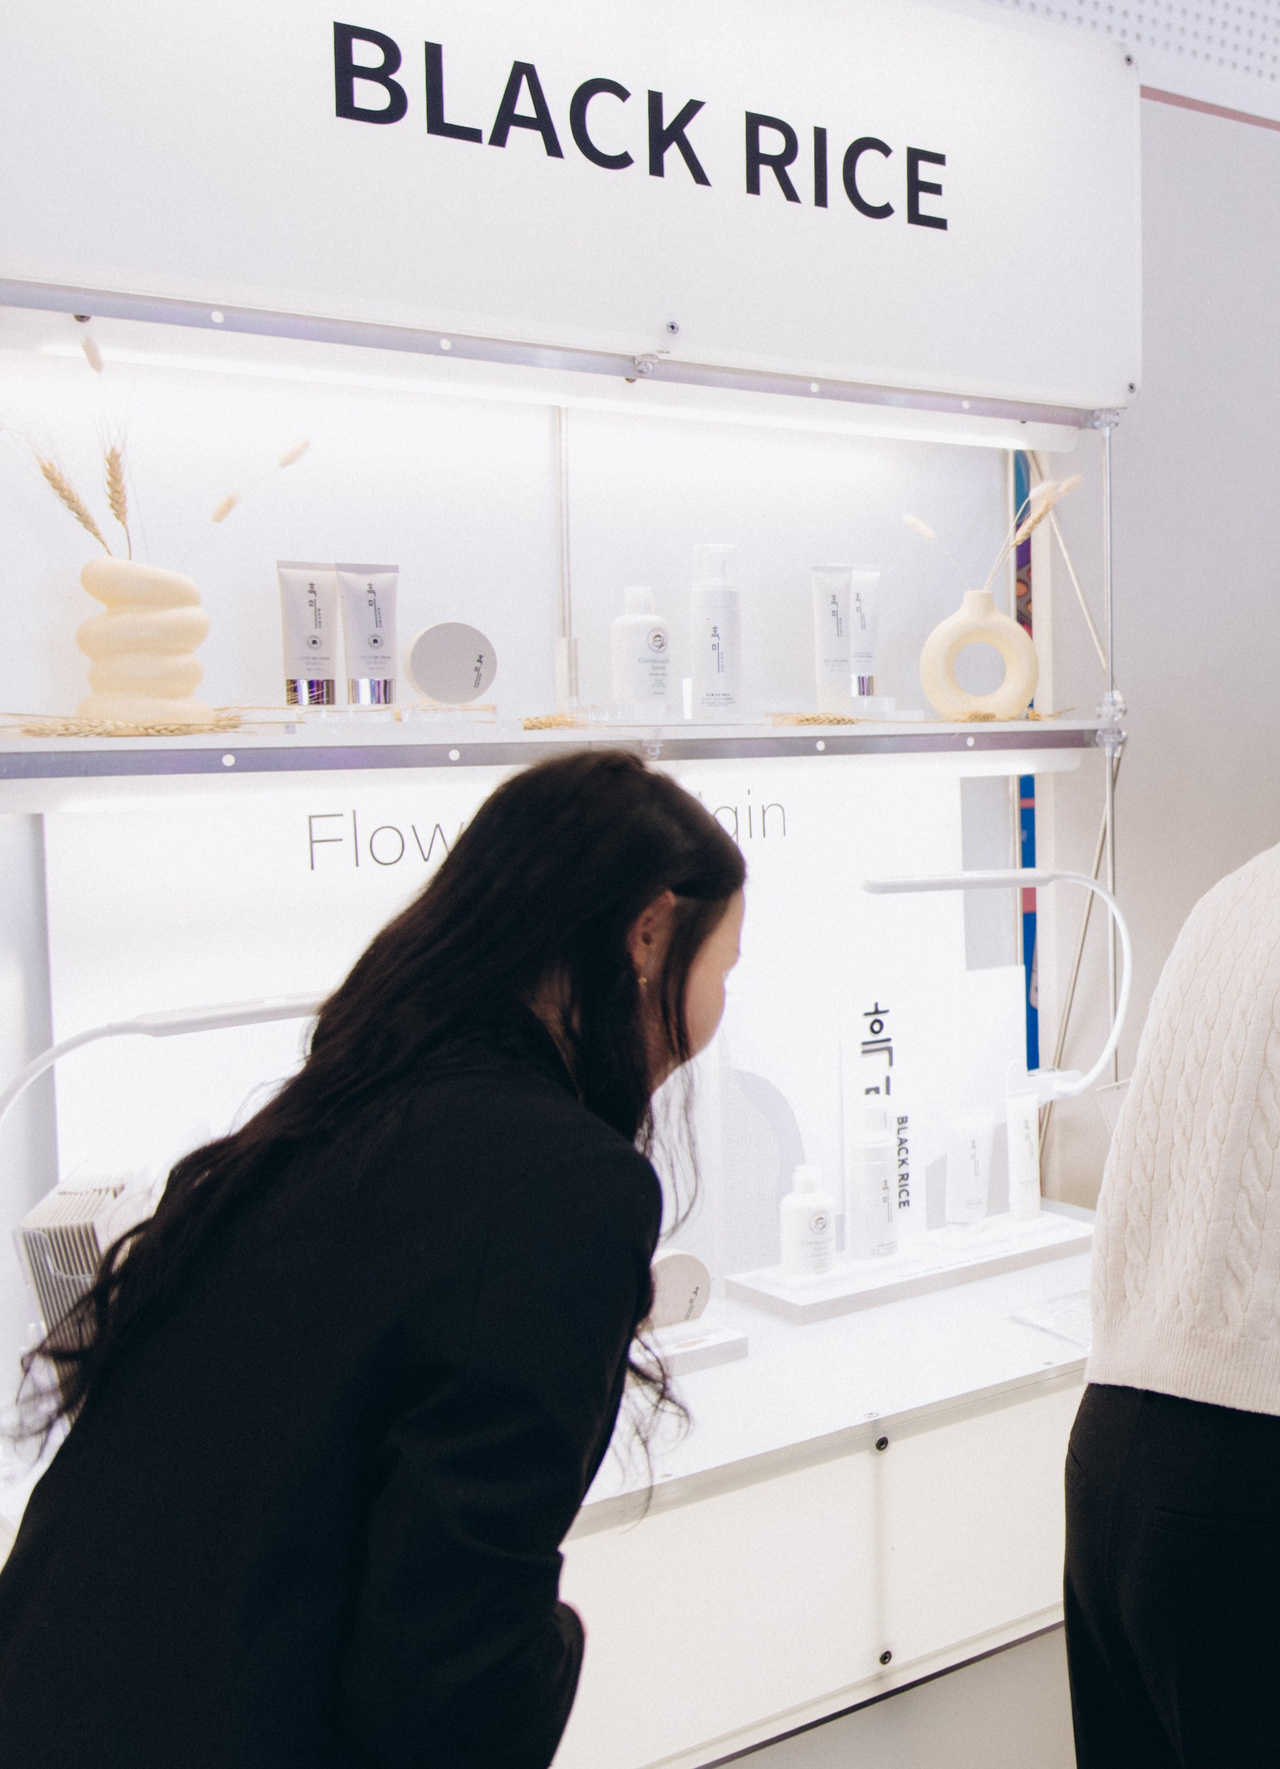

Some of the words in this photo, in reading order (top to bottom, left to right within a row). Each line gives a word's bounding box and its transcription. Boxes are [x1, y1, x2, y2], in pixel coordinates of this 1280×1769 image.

[332, 21, 712, 188] BLACK
[744, 110, 949, 232] RICE
[699, 788, 786, 846] gin
[897, 1116, 909, 1168] BLACK
[898, 1172, 910, 1209] RICE
